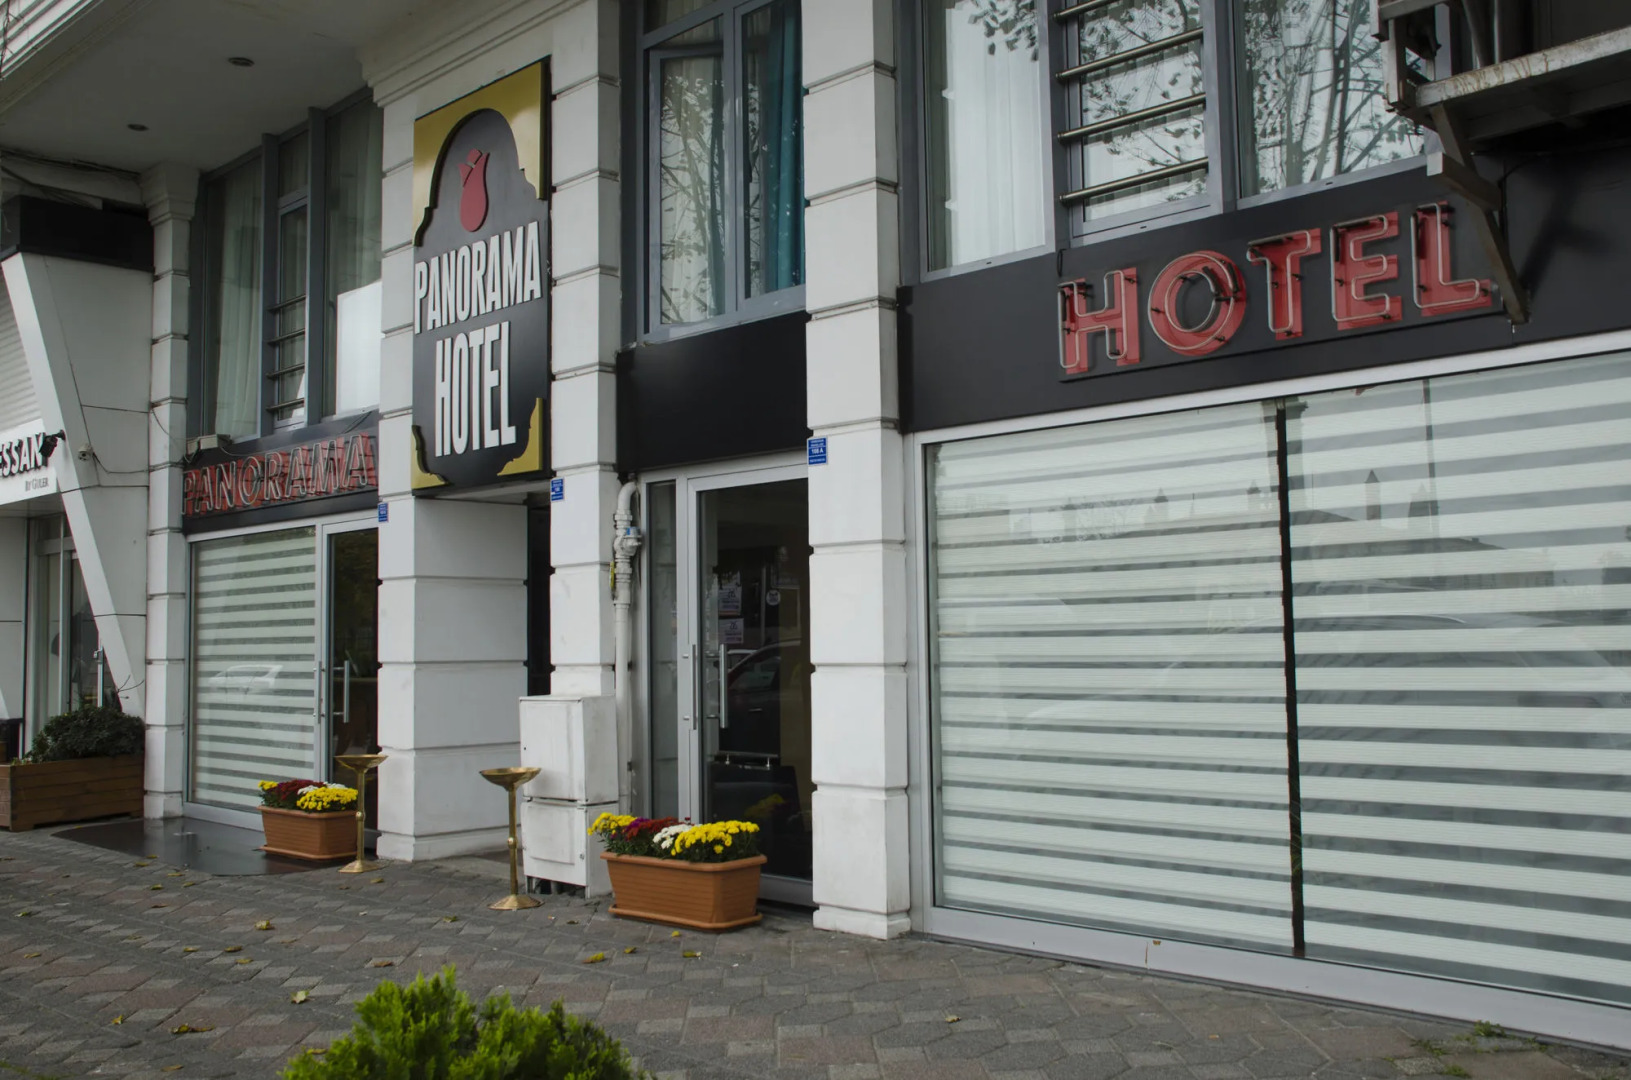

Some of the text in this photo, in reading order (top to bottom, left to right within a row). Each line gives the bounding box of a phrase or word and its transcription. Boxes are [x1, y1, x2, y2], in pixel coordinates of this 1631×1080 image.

[414, 221, 543, 335] PANORAMA
[1058, 202, 1492, 374] HOTEL
[434, 321, 517, 458] HOTEL
[0, 431, 46, 478] SSAN
[182, 432, 377, 516] PANORAMA
